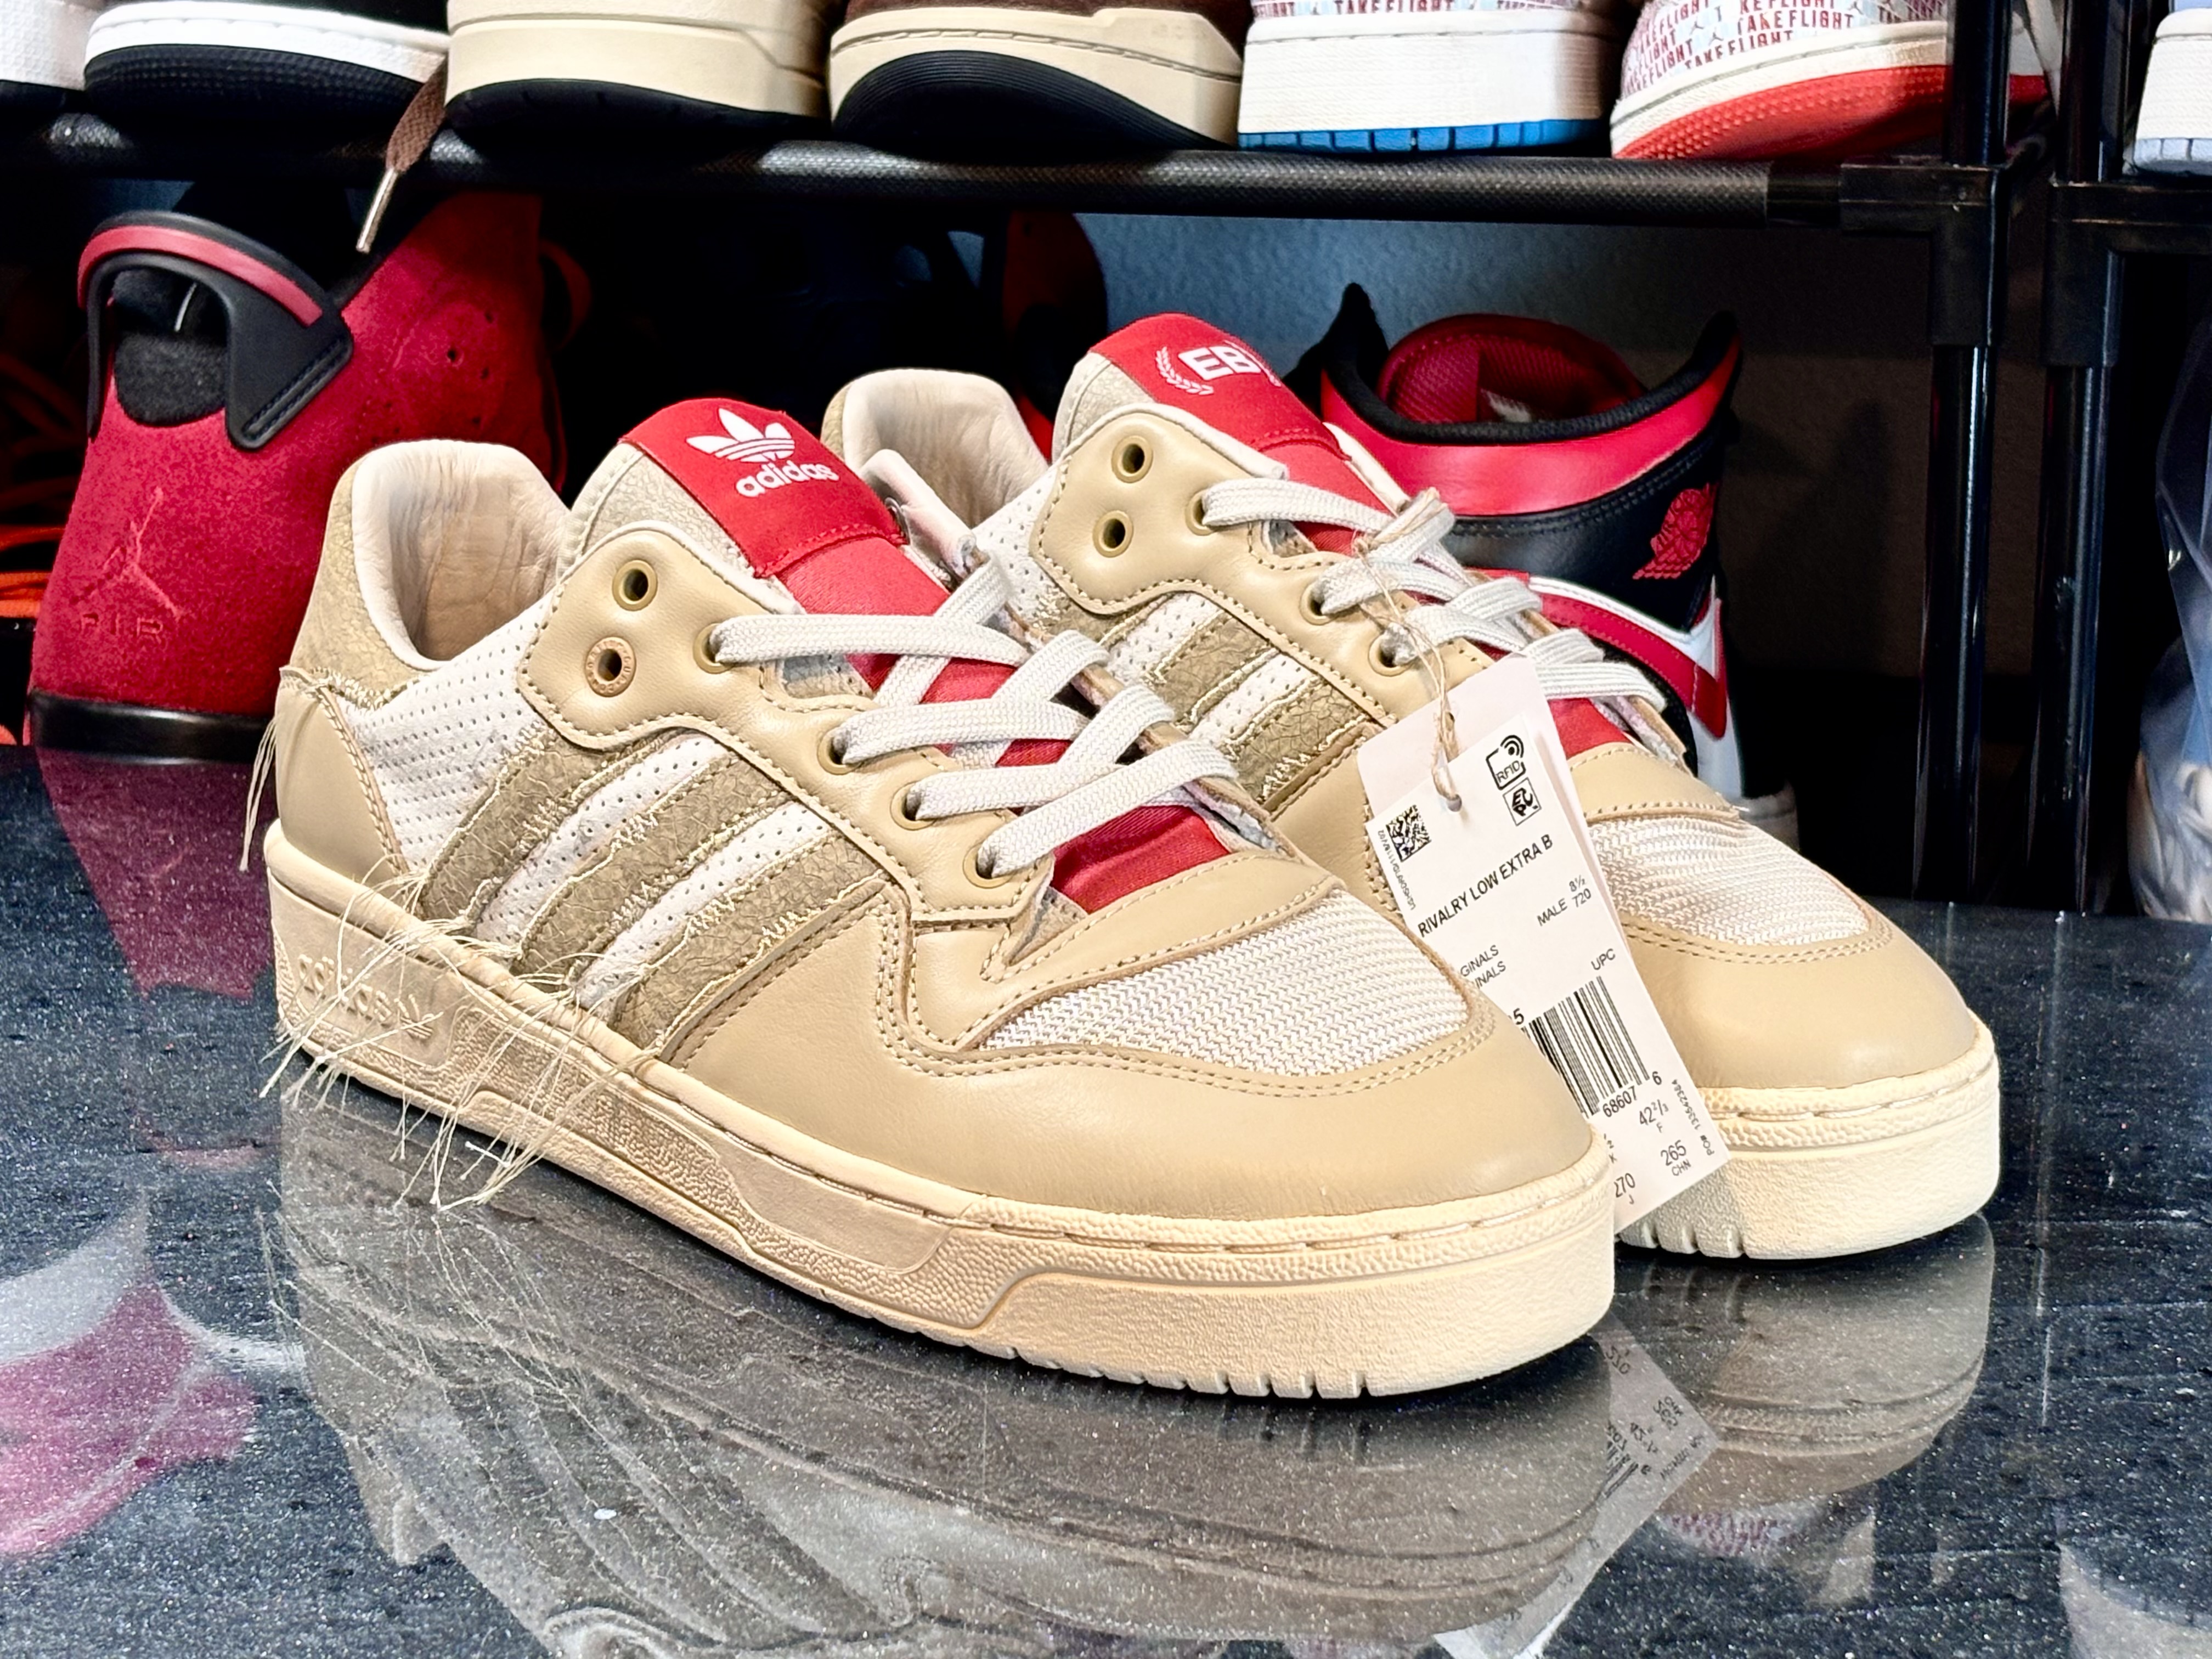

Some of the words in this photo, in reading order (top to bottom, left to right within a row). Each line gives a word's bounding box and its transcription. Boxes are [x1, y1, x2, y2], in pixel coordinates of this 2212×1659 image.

[1737, 10, 1854, 35] TAKEFLIGHT
[736, 460, 839, 497] adidas
[1496, 760, 1520, 783] RFID
[1418, 891, 1469, 938] RIVALRY
[1469, 871, 1499, 901] LOW
[1499, 843, 1543, 880] EXTRA
[1541, 834, 1553, 850] B
[1537, 898, 1568, 926] MALE
[1572, 888, 1592, 908] 720
[1590, 948, 1616, 970] UPC
[1602, 1086, 1637, 1118] 68607
[1652, 1071, 1662, 1085] 6
[1660, 1139, 1687, 1166] 265
[1671, 1159, 1691, 1176] CHN
